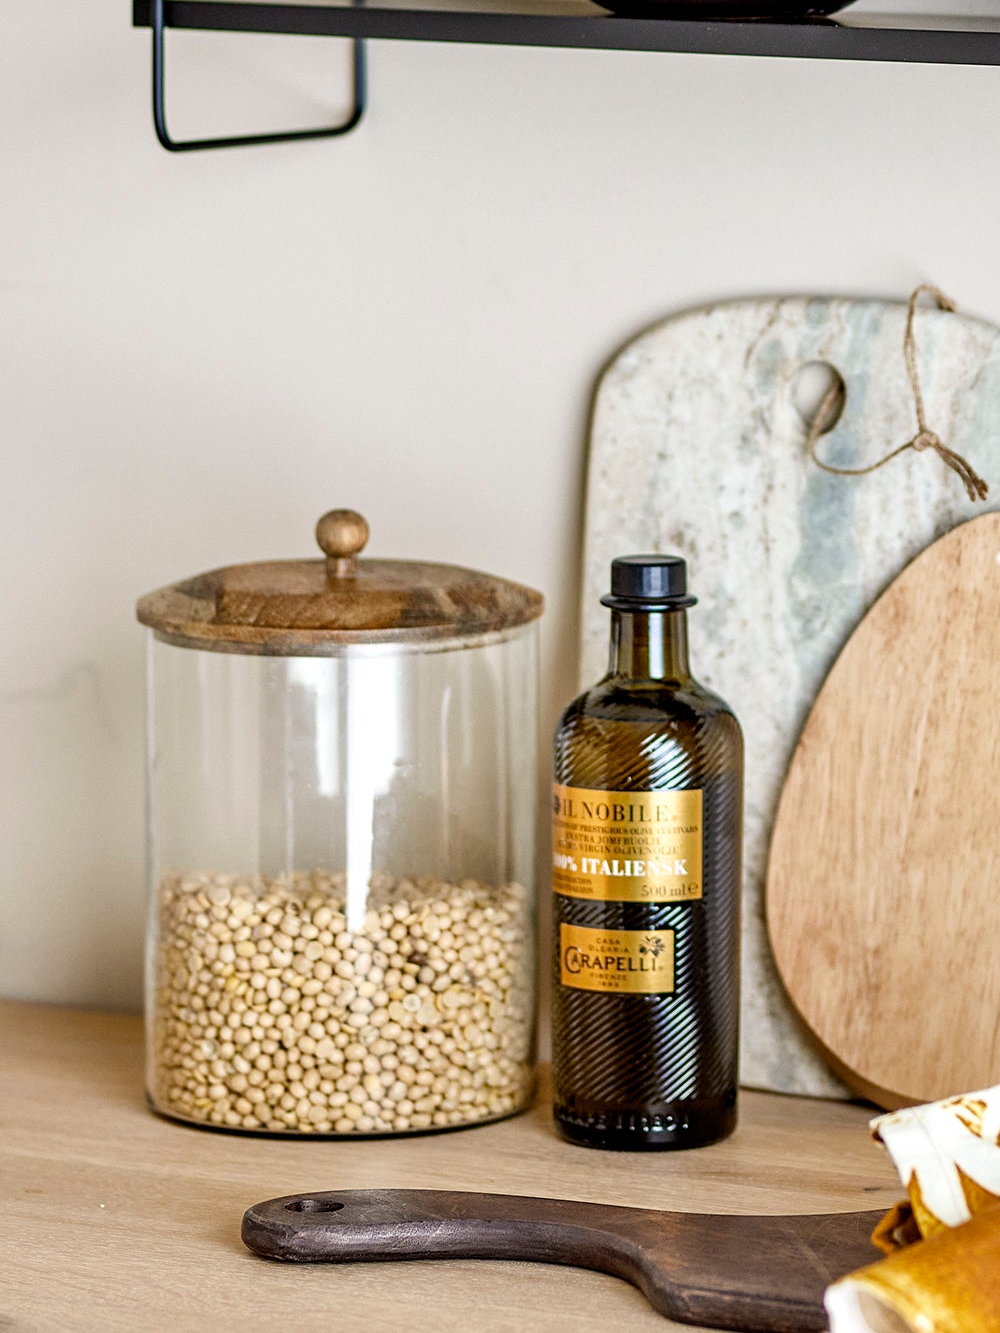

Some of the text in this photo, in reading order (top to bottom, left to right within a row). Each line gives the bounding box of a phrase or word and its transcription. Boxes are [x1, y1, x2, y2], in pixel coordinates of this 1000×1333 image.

[582, 802, 669, 822] NOBILE
[581, 857, 688, 877] ITALIENSK
[564, 946, 657, 974] CARAPELLI
